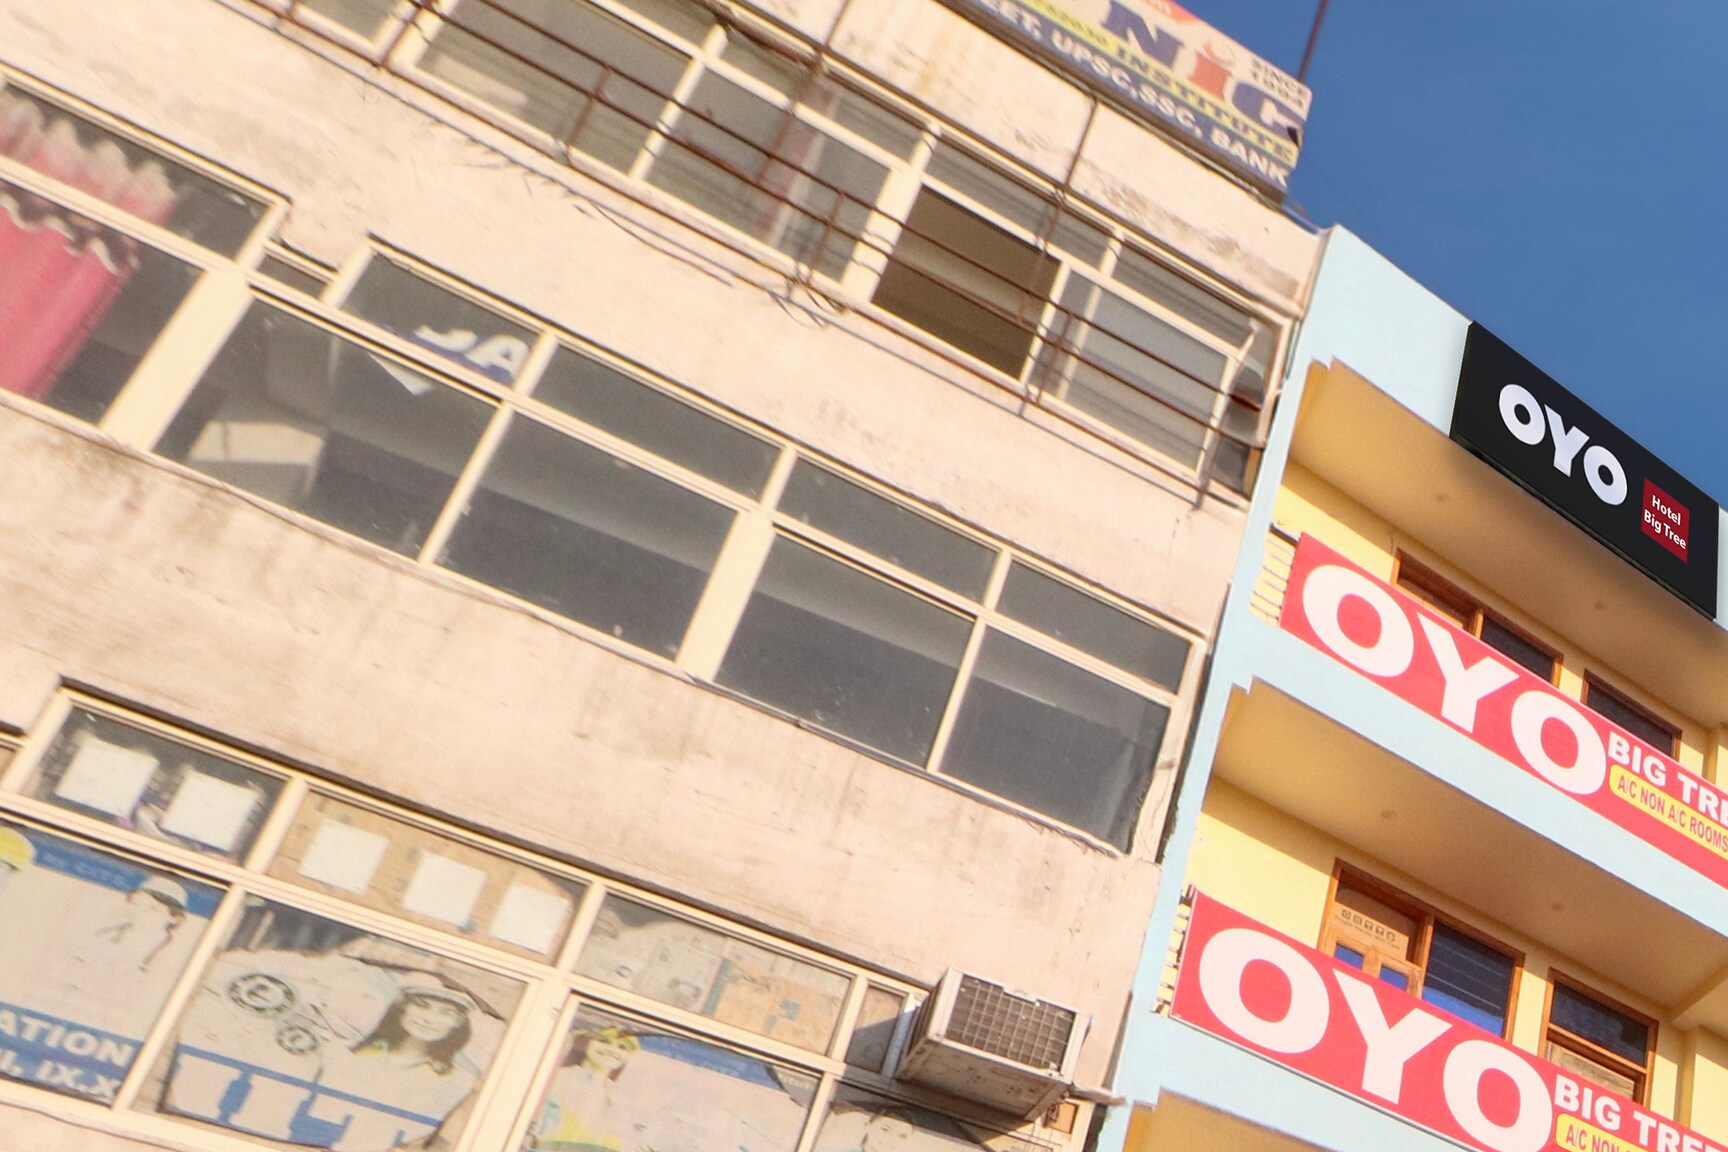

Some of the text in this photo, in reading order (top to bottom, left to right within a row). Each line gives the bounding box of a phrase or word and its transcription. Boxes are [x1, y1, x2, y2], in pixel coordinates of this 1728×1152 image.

[1210, 125, 1288, 188] BANK
[1498, 383, 1628, 506] OYO
[1643, 509, 1688, 551] Big Tree
[1651, 494, 1682, 526] Hotel
[1303, 565, 1607, 795] OYO
[1608, 730, 1666, 787] BIG
[1617, 773, 1637, 798] A/C
[1640, 784, 1665, 814] NON
[1668, 801, 1688, 828] A/C
[1689, 811, 1728, 855] ROOMS
[1555, 1073, 1621, 1131] BIG
[1565, 1124, 1588, 1148] A/C
